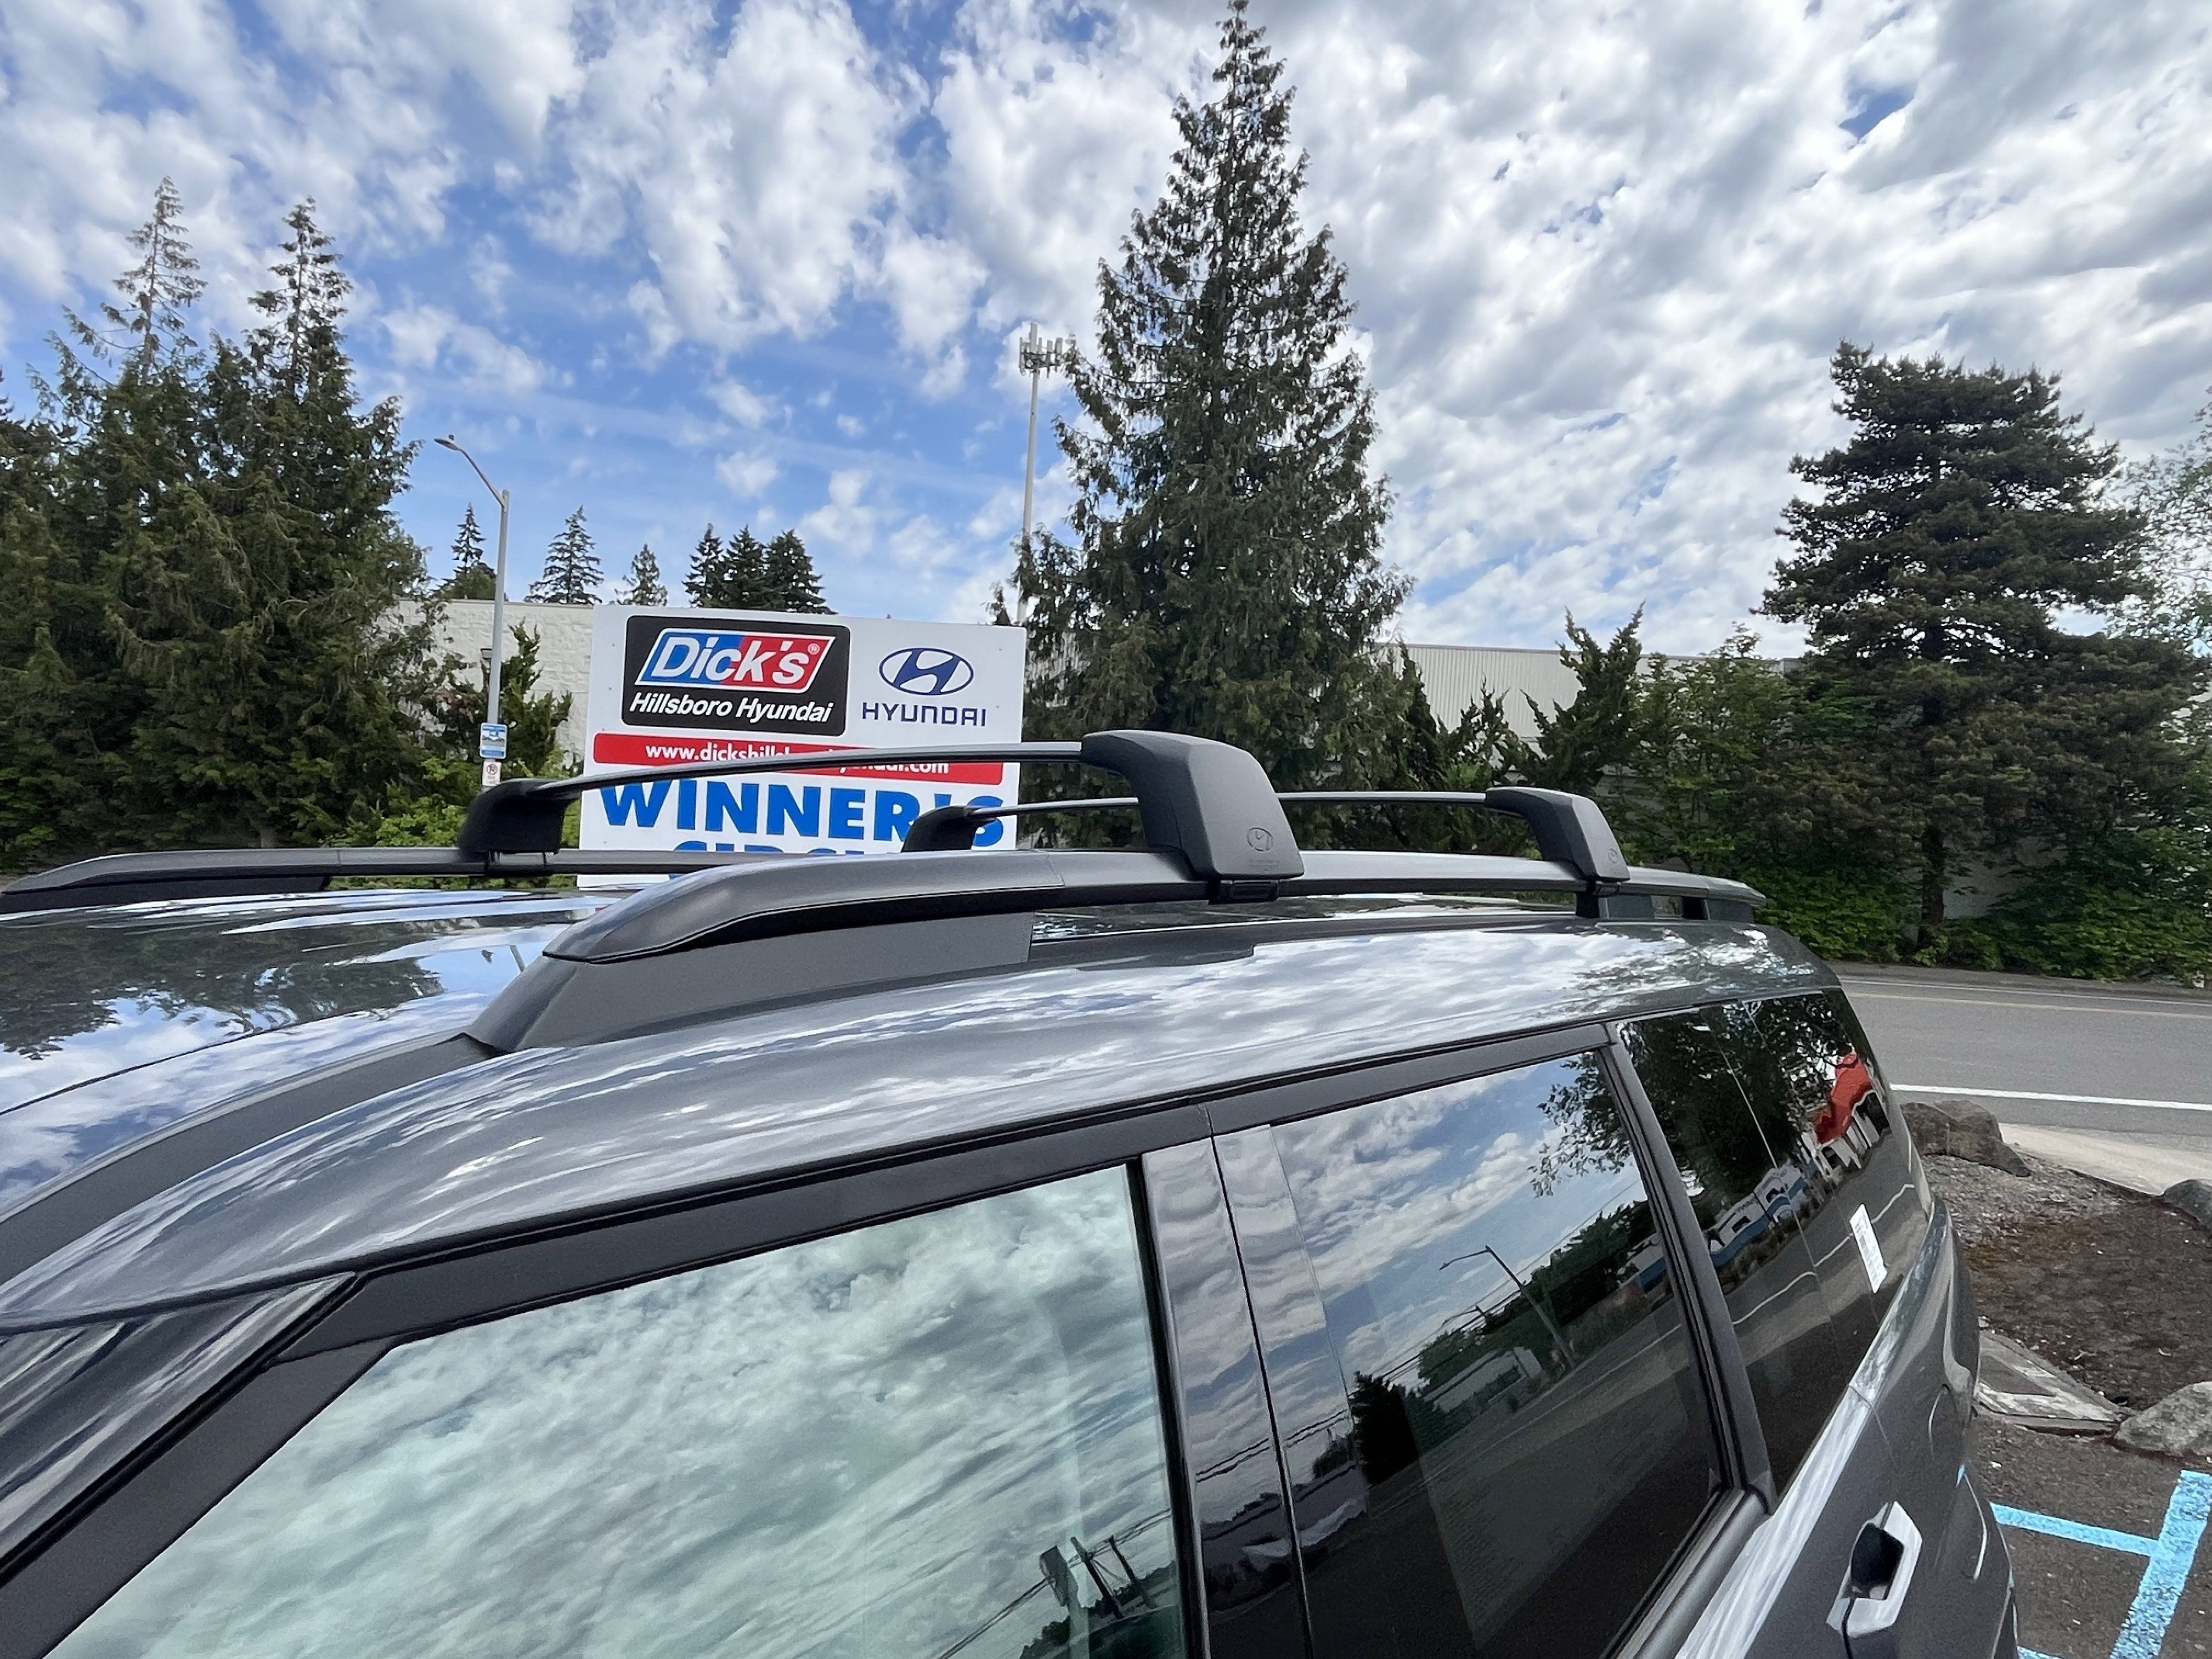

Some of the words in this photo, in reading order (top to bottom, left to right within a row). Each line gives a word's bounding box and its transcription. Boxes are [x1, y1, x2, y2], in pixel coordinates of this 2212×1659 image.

[651, 636, 810, 685] Dick's
[629, 692, 733, 716] Hillsboro
[735, 697, 834, 723] Hyundai
[862, 702, 986, 726] HYUNDAI
